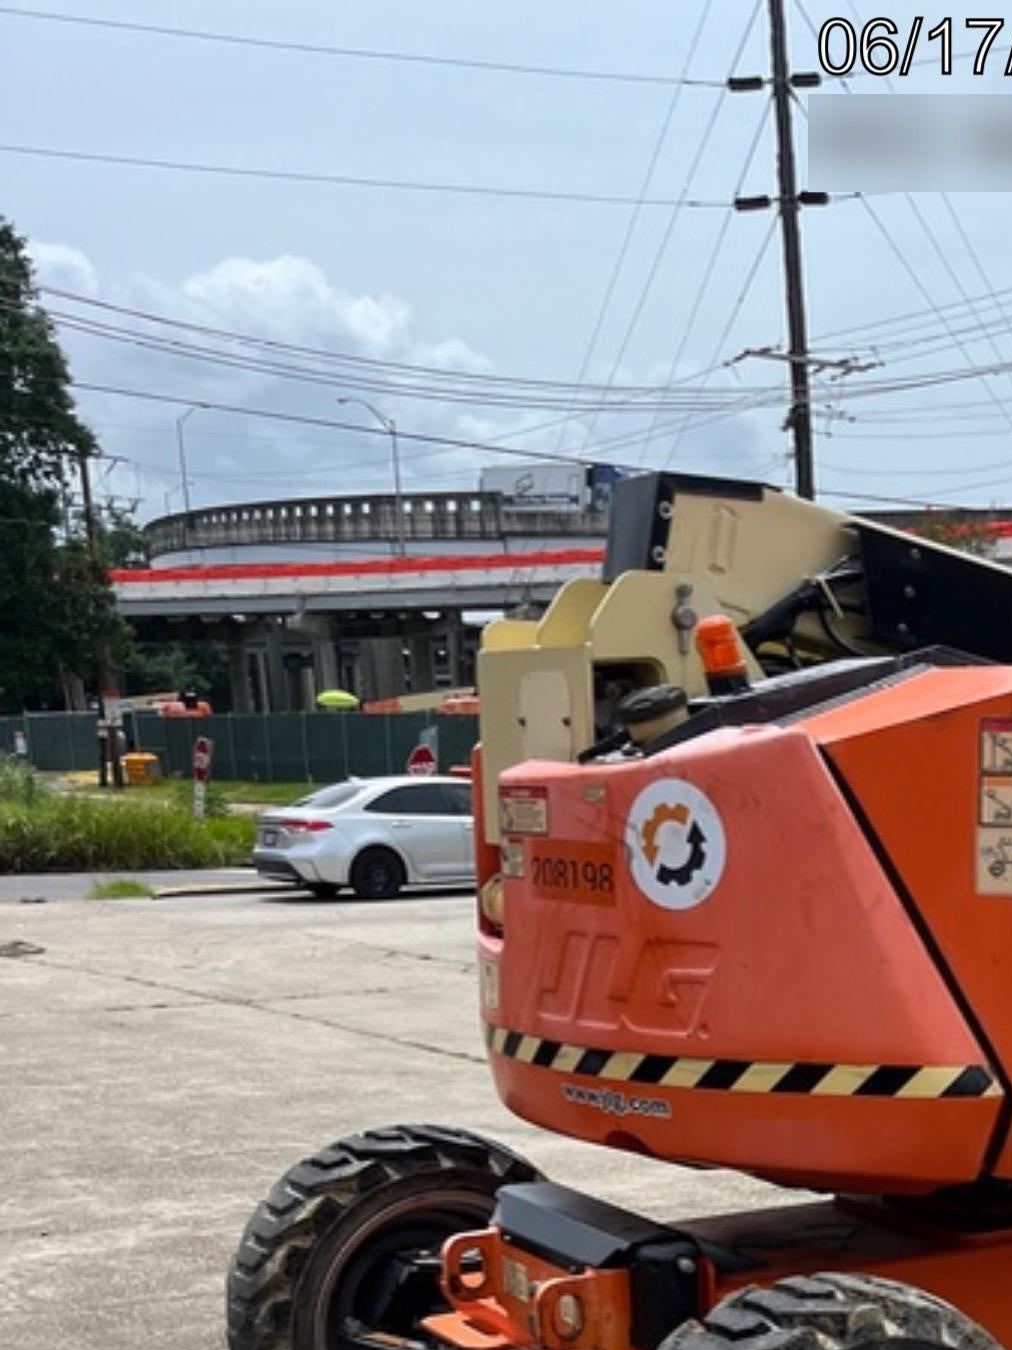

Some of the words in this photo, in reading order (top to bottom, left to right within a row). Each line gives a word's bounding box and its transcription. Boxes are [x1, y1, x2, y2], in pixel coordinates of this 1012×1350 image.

[531, 856, 615, 893] 208198
[537, 930, 719, 1038] JLG
[563, 1083, 672, 1118] www.jlg.com
